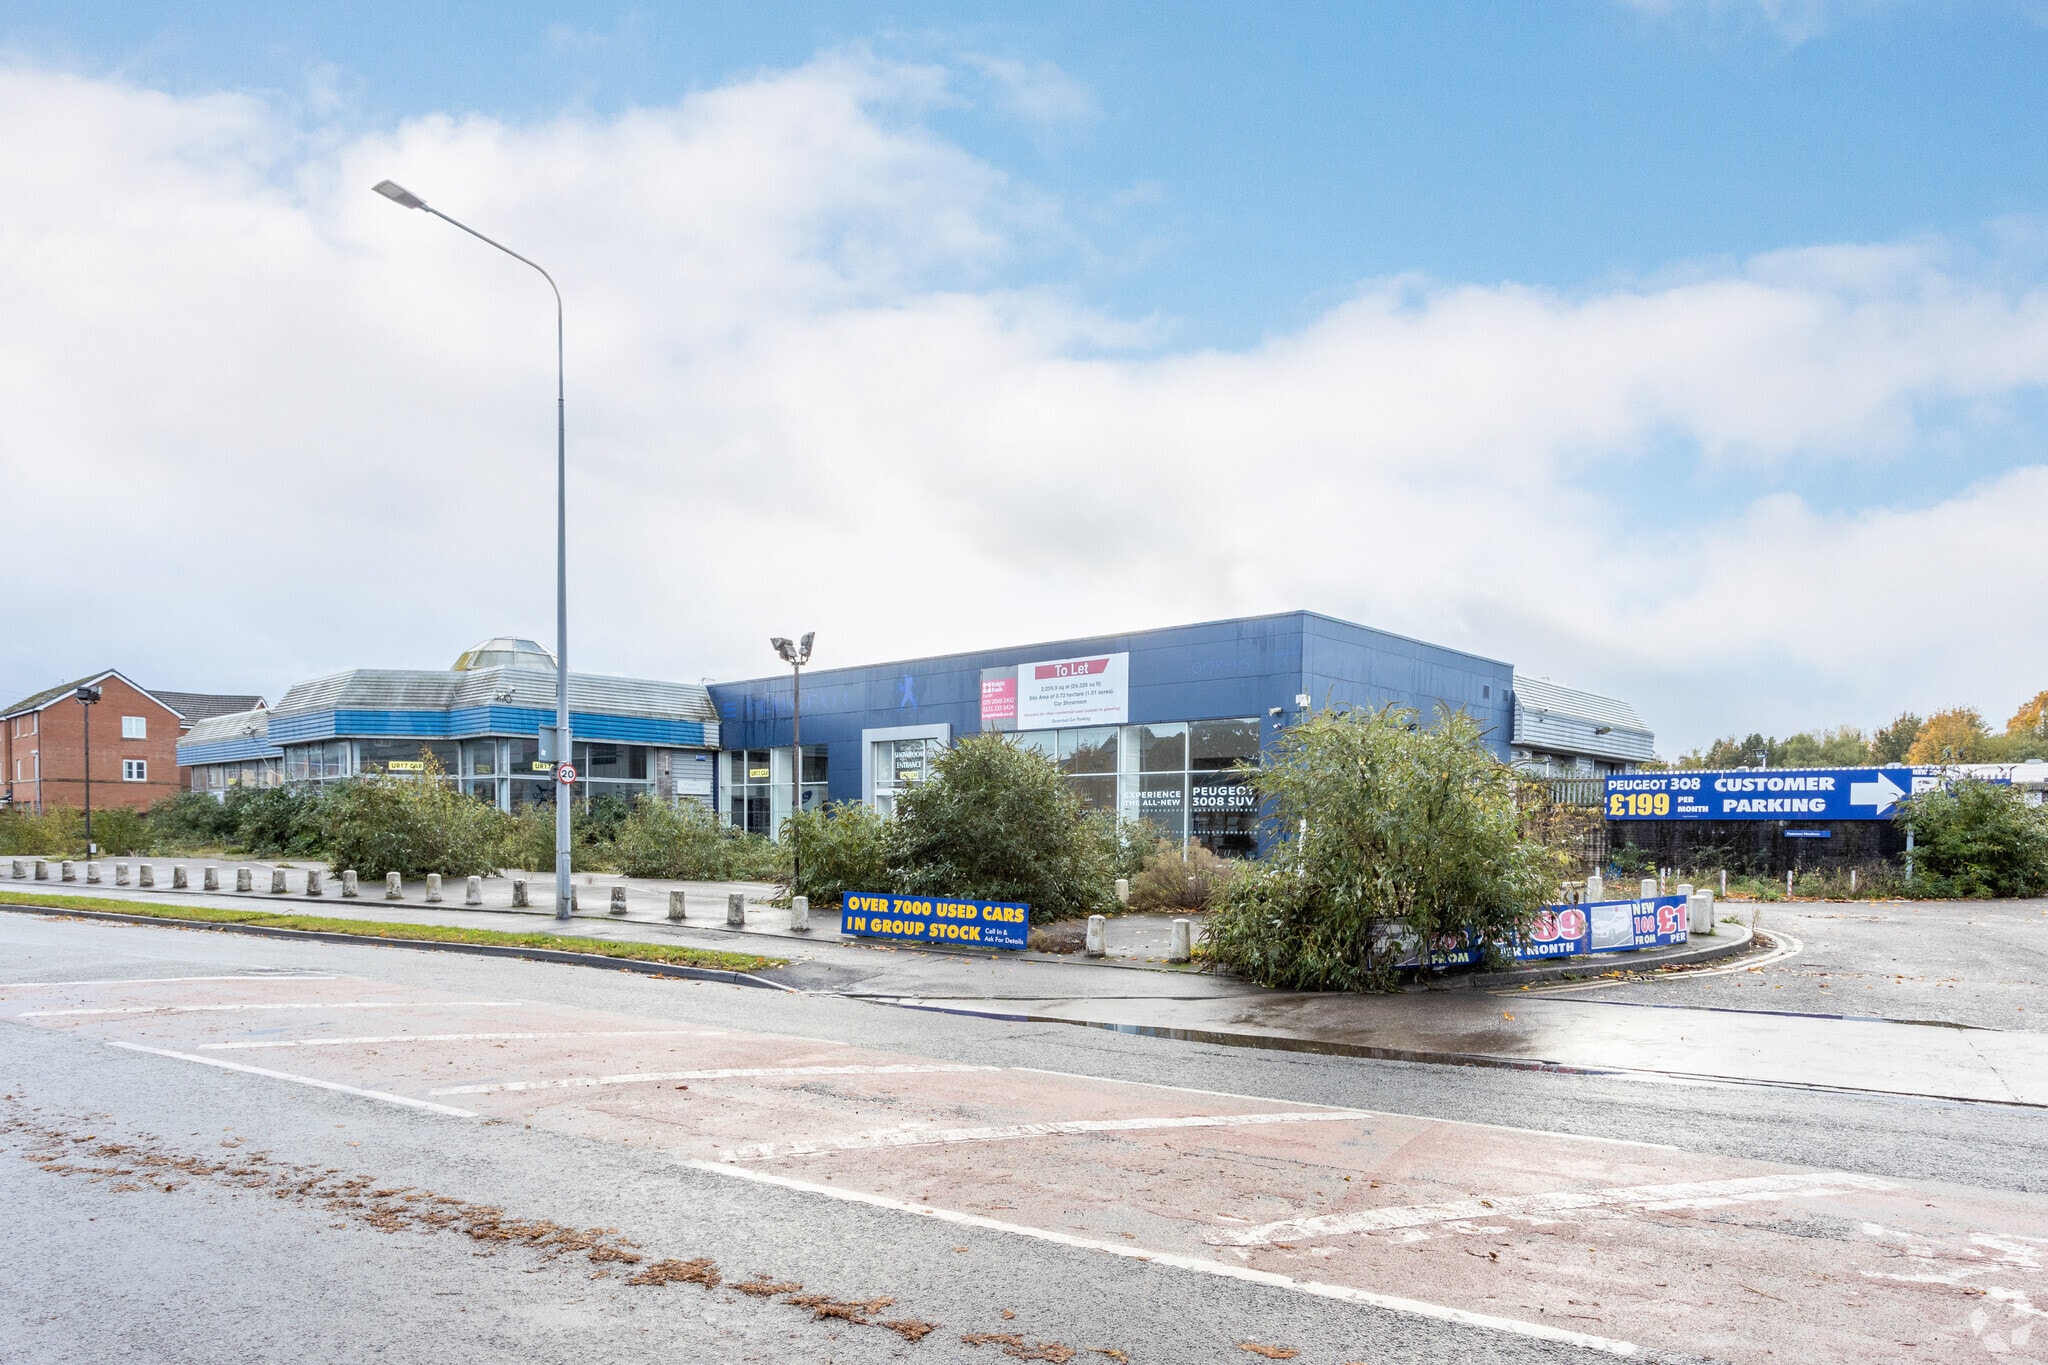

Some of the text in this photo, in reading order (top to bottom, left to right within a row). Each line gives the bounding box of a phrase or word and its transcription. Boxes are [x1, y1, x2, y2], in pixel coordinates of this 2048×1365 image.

[1055, 663, 1088, 677] To Let
[562, 770, 574, 778] 20
[1608, 778, 1700, 790] PEUGEOT 308
[1714, 777, 1835, 792] CUSTOMER
[1193, 786, 1253, 796] PEUGEOT
[1193, 797, 1254, 806] 3008 SUV
[1610, 793, 1670, 815] £199
[1723, 798, 1825, 812] PARKING
[848, 897, 1025, 923] OVER 7000 USED CARS
[1632, 902, 1654, 915] NEW
[847, 917, 981, 940] IN GROUP STOCK
[1634, 916, 1655, 933] 108
[1636, 935, 1656, 945] FROM
[1671, 932, 1686, 943] PER
[1526, 942, 1574, 955] MONTH
